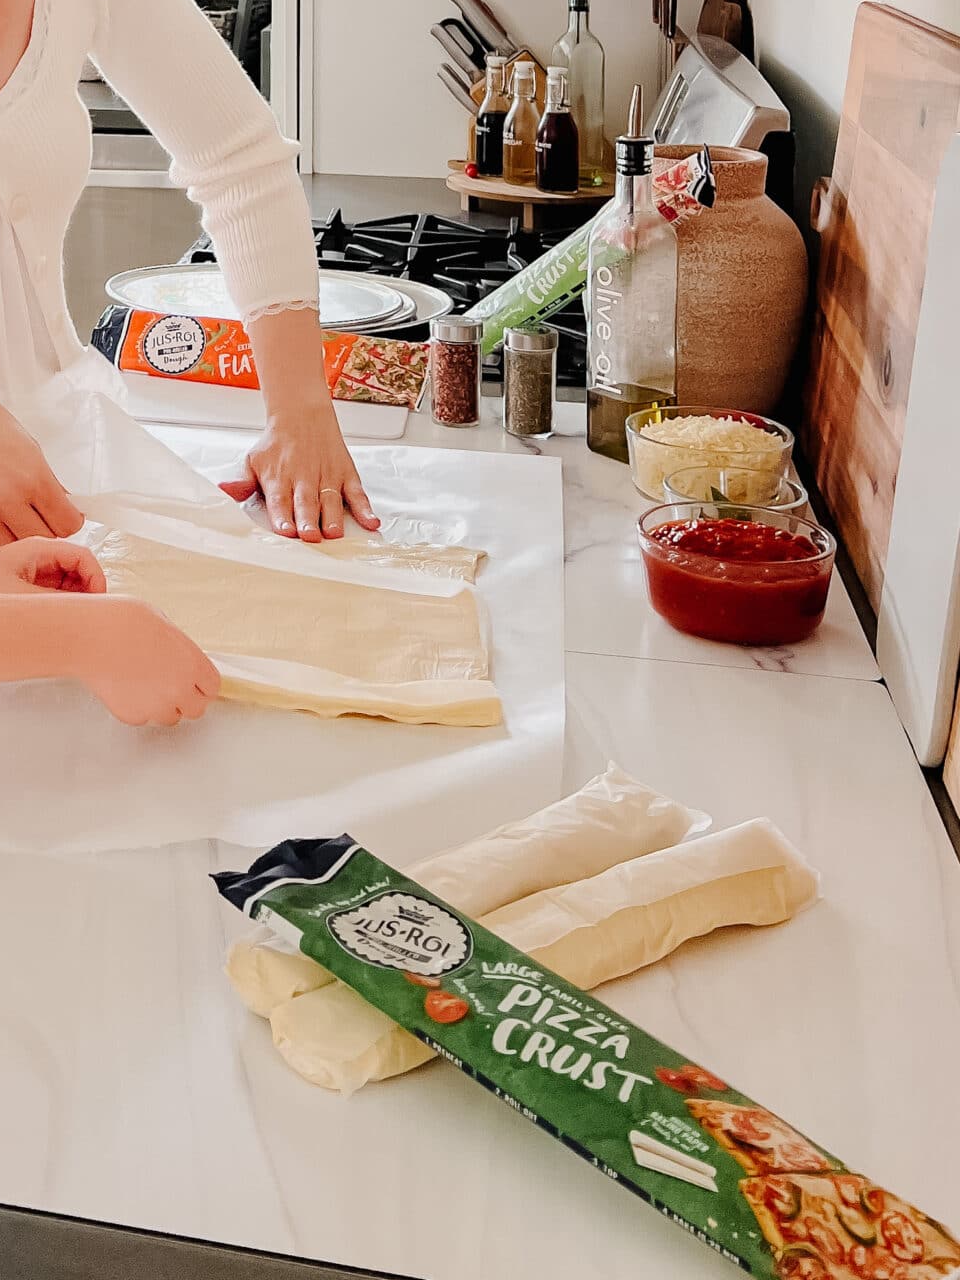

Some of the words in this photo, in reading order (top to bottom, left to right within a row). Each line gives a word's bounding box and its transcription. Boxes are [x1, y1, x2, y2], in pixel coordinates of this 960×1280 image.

[526, 246, 575, 305] CRUST
[596, 266, 623, 341] olive
[596, 349, 623, 395] oil
[481, 961, 545, 982] LARGE
[542, 983, 596, 1013] FAMILY
[497, 983, 631, 1060] PIZZA
[491, 1017, 654, 1104] CRUST
